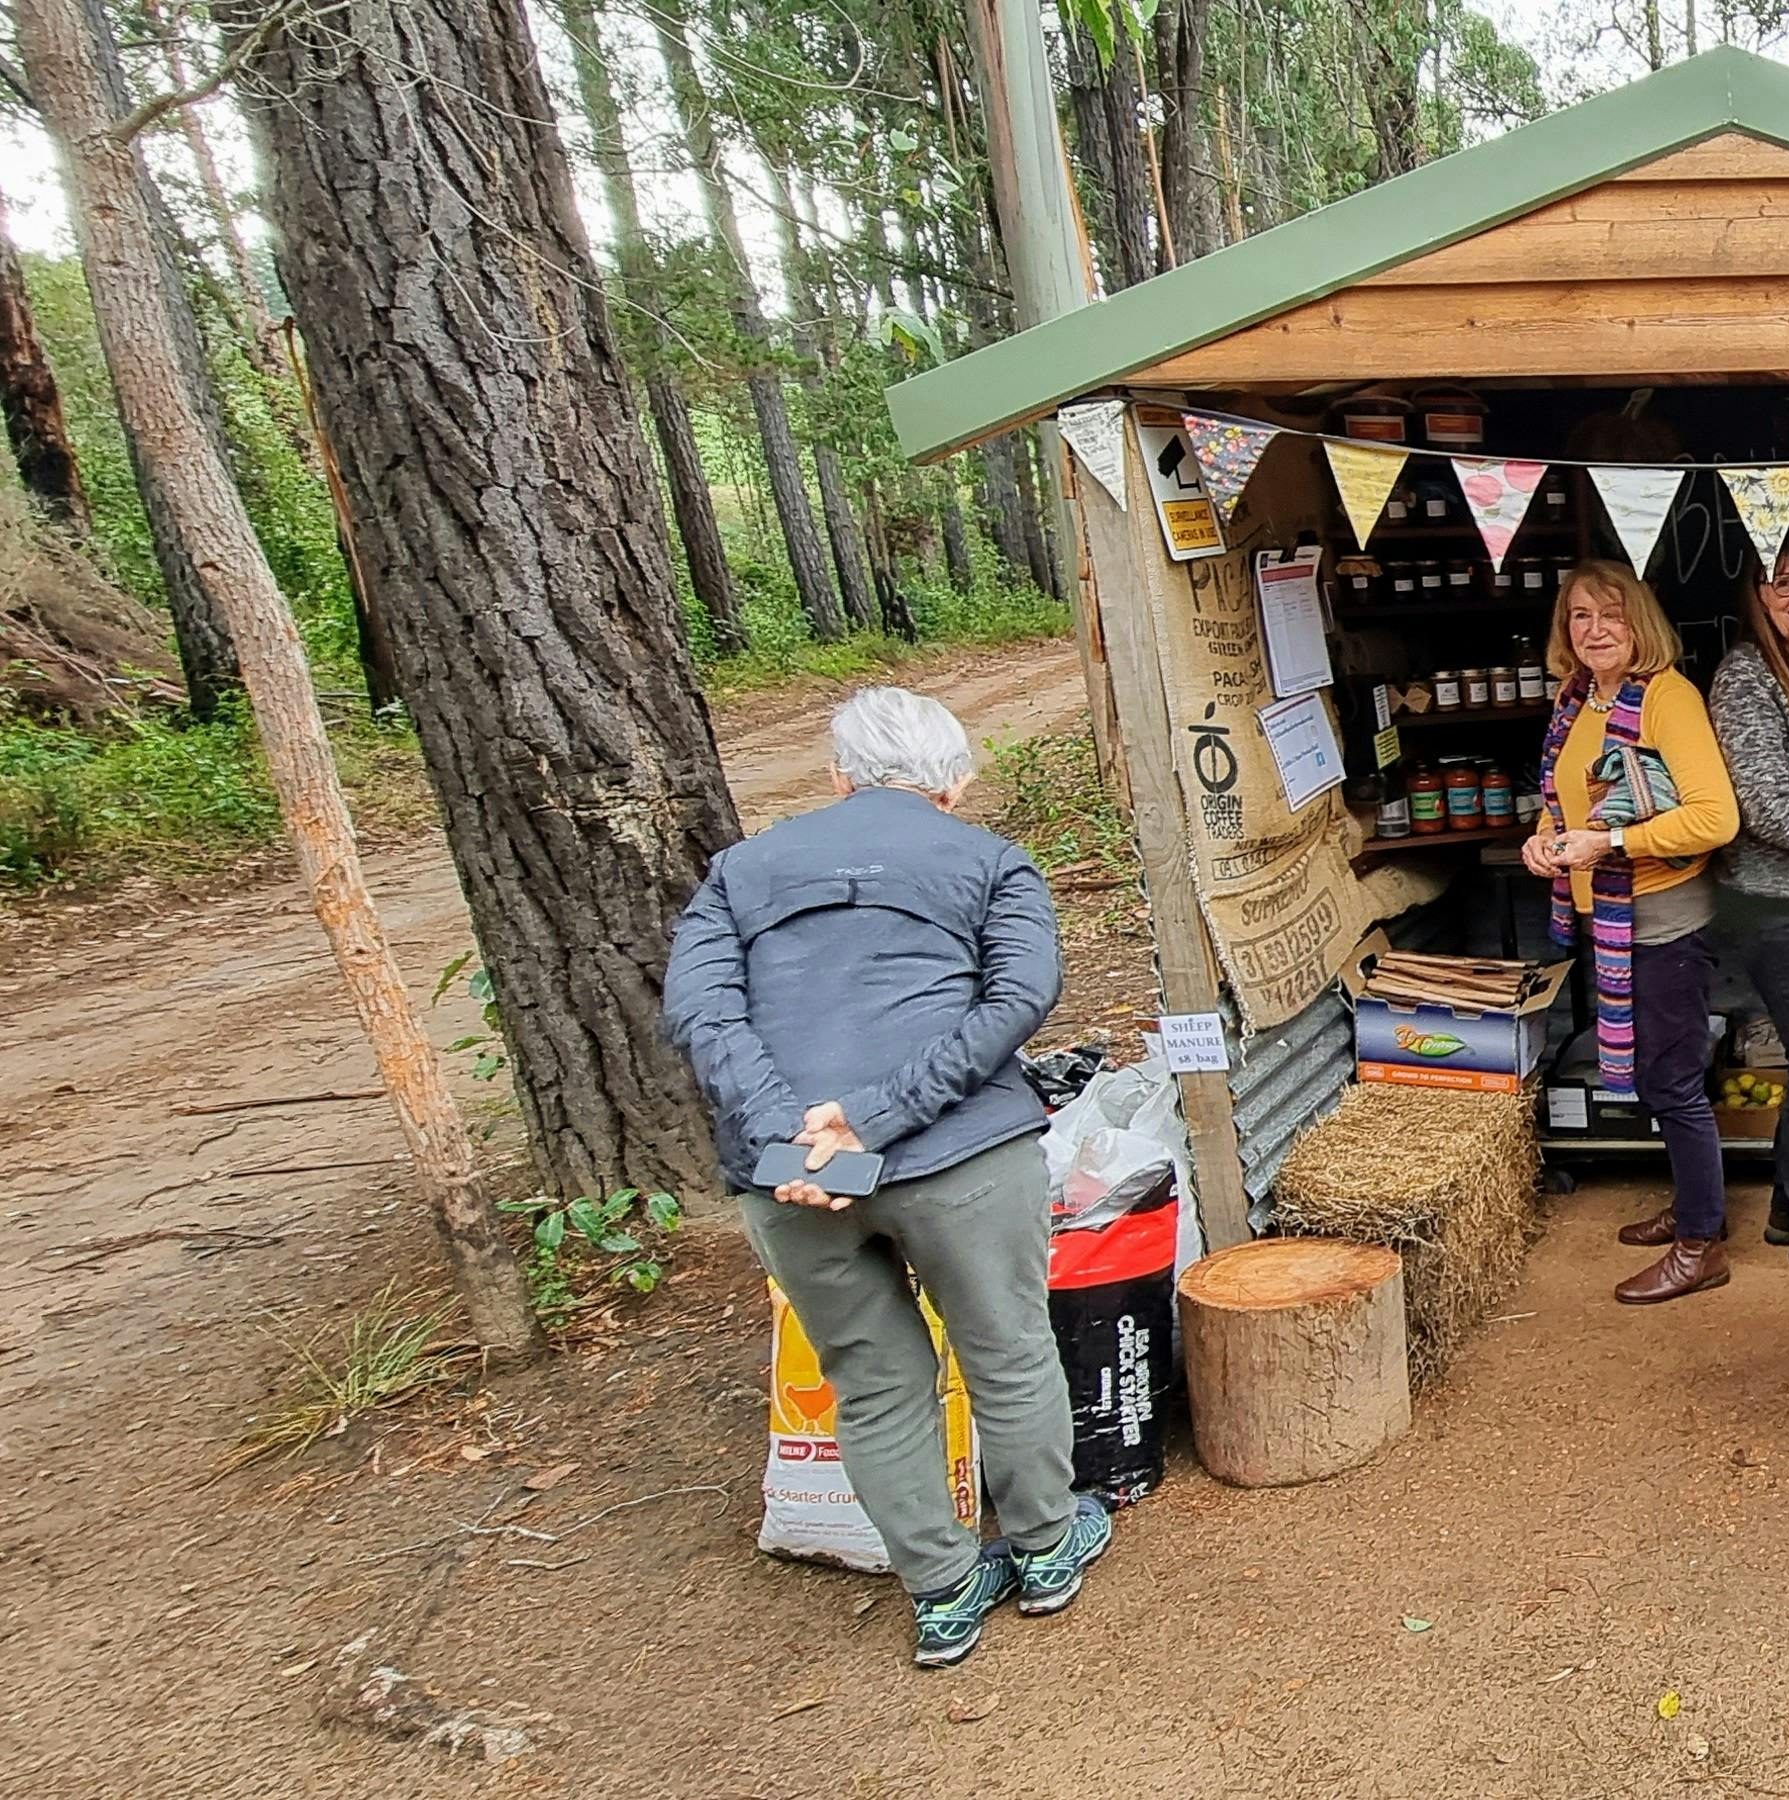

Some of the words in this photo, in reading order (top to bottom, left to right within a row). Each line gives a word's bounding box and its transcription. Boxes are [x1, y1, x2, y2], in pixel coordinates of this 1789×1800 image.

[1200, 794, 1243, 810] ORIGIN
[1203, 810, 1243, 827] COFFEE
[1205, 825, 1245, 840] TRADERS
[1171, 1021, 1213, 1033] SHEEP
[1167, 1036, 1222, 1048] MANURE
[1195, 1053, 1219, 1065] bag
[1117, 1315, 1136, 1373] CHICK
[1135, 1328, 1150, 1359] ISA
[1135, 1359, 1153, 1422] BROWN
[1119, 1374, 1141, 1447] STARTER
[779, 1489, 824, 1503] Starter
